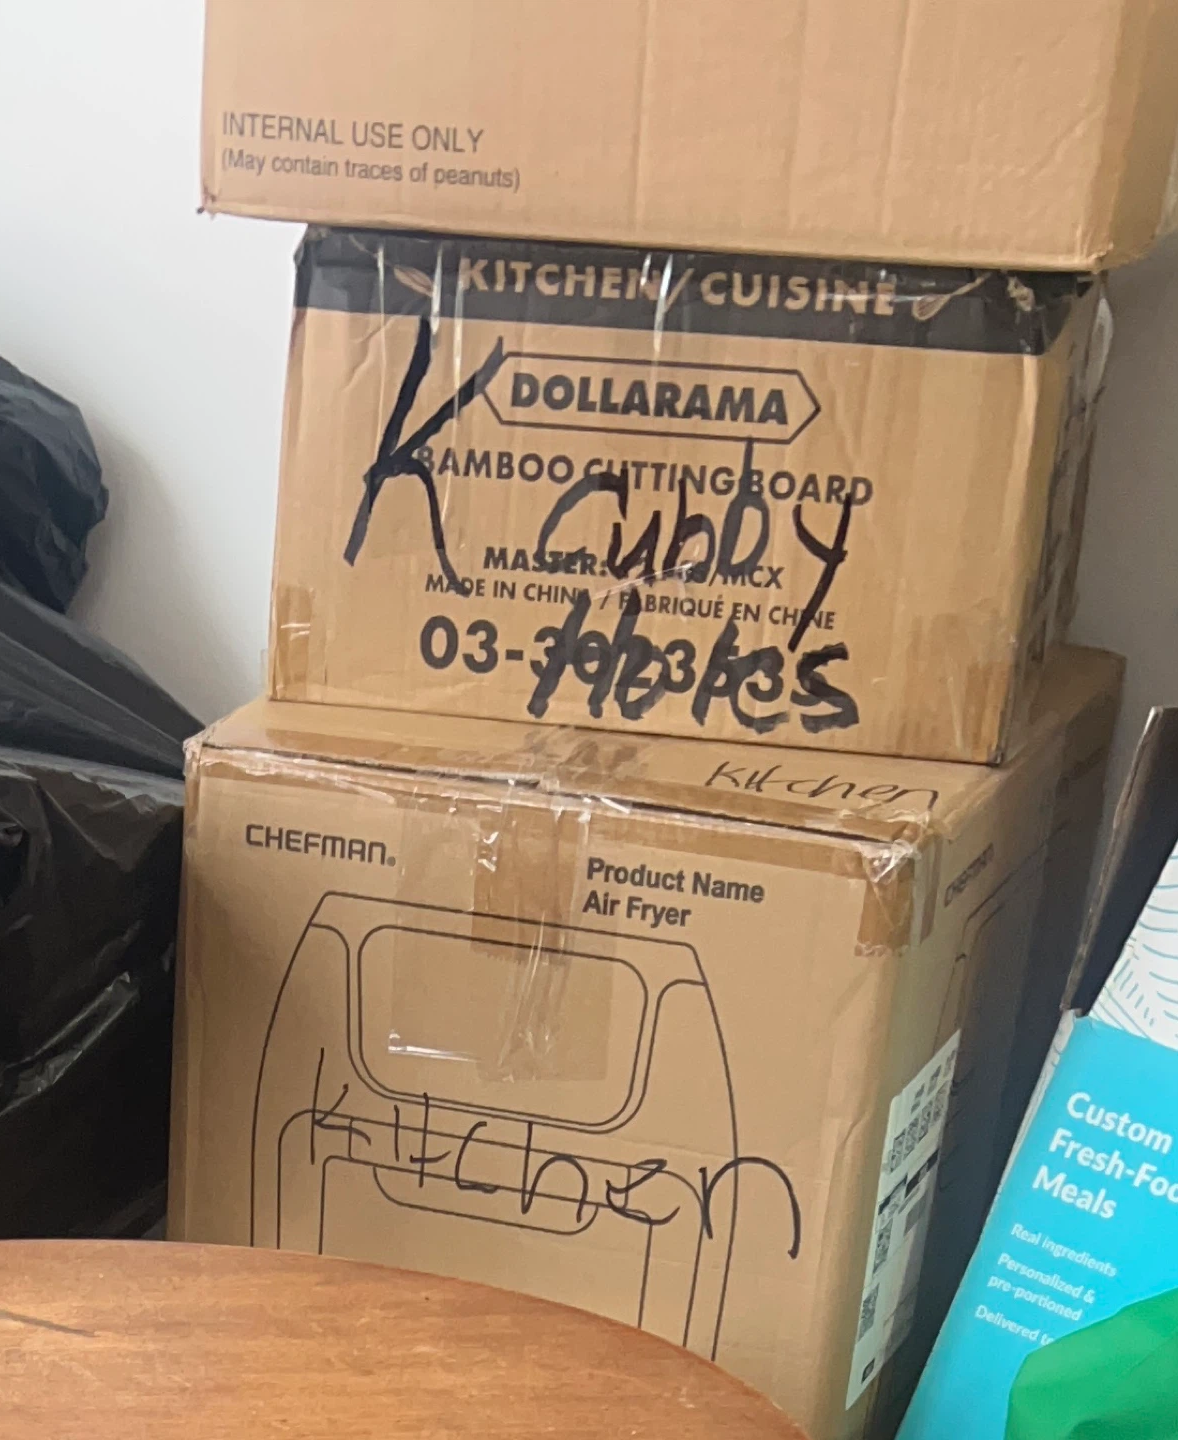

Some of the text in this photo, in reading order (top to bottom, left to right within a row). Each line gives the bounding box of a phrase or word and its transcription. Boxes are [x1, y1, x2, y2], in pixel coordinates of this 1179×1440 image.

[223, 112, 484, 153] INTERNAL USE ONLY
[222, 149, 520, 193] (May contain traces of peanuts)
[511, 372, 789, 425] DOLLARAMA
[343, 308, 504, 599] K
[416, 446, 874, 507] BAMBOO CUTTING BOARD
[425, 573, 485, 598] MADE
[493, 579, 516, 599] IN
[618, 588, 723, 620] FBRIQUÉ
[732, 601, 761, 623] EN
[245, 824, 388, 865] CHEFMAN
[586, 857, 765, 904] Product Name
[582, 889, 692, 929] Air Fryer
[1066, 1092, 1172, 1156] Custom
[1032, 1164, 1118, 1219] Meals
[1010, 1223, 1118, 1278] Real ingredients
[997, 1252, 1096, 1305] Personalized &
[975, 1304, 1040, 1341] Delivered
